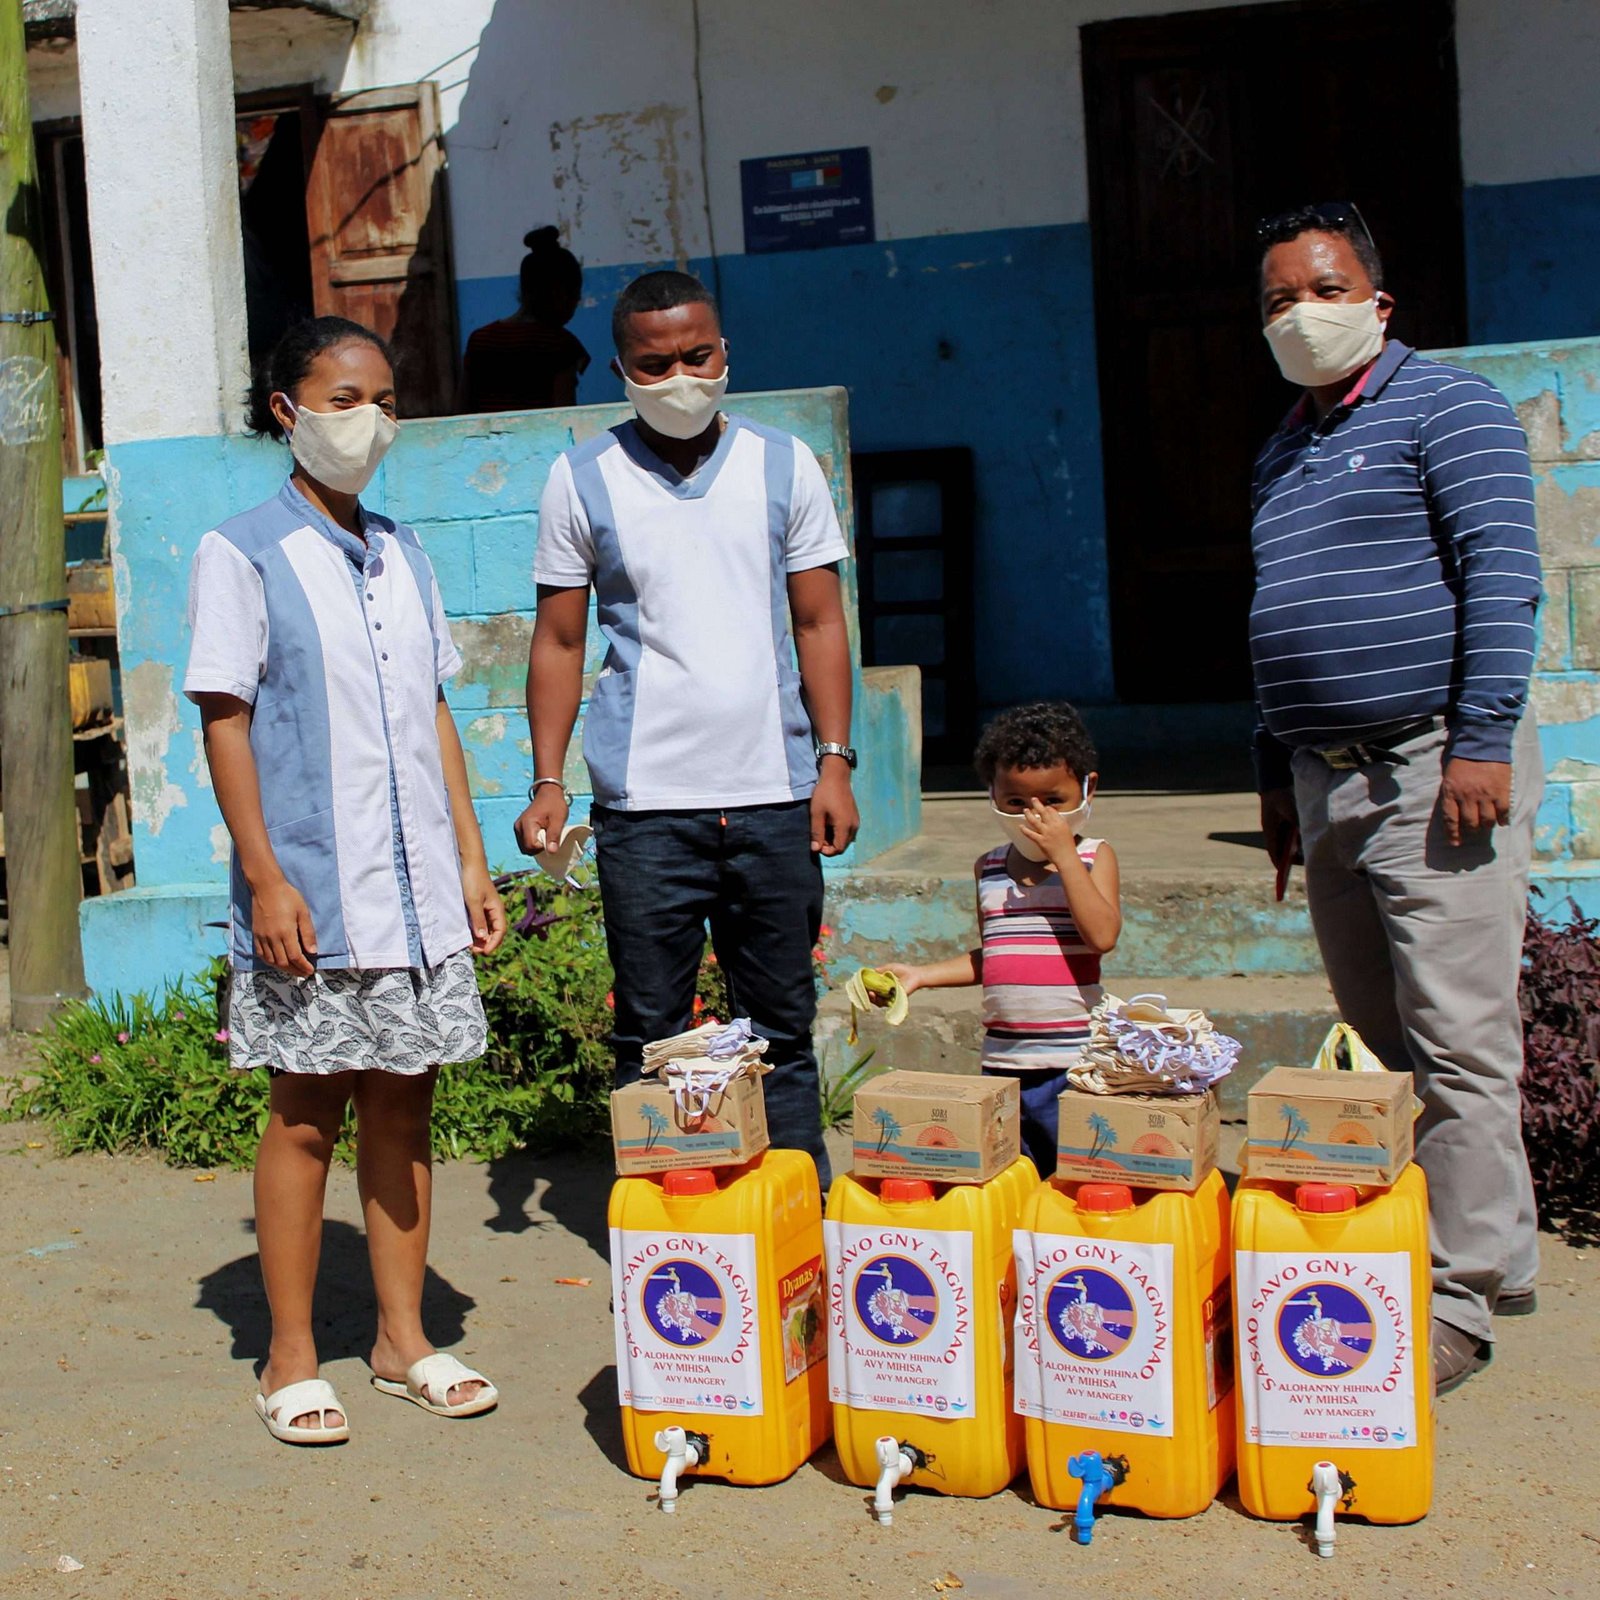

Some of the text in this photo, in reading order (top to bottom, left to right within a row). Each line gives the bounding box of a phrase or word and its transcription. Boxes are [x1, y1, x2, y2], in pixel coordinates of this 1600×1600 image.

[623, 1244, 659, 1285] SAVO
[666, 1239, 709, 1255] GNY
[714, 1252, 753, 1364] TAGNANAO
[837, 1237, 872, 1276] SAVO
[879, 1233, 924, 1251] GNY
[929, 1248, 968, 1364] TAGNANAO
[1028, 1249, 1068, 1289] SAVO
[1075, 1244, 1122, 1264] GNY
[1127, 1261, 1167, 1380] TAGNANAO
[1247, 1259, 1407, 1392] SASAO SAVO GNY TAGNANAO
[698, 1354, 730, 1364] HIHINA
[910, 1354, 943, 1364] HIHINA
[653, 1363, 711, 1374] AVY MIHISA
[864, 1359, 923, 1373] AVY MIHISA
[875, 1374, 939, 1386] AVY MANGERY
[1103, 1369, 1139, 1380] HIHINA
[665, 1375, 726, 1386] AVY MANGERY
[1053, 1373, 1117, 1389] AVY MIHISA
[1343, 1384, 1380, 1393] HIHINA
[1066, 1388, 1134, 1402] AVY MANGERY
[1289, 1394, 1358, 1404] AVY MIHISA
[1304, 1408, 1376, 1417] AVY MANGERY
